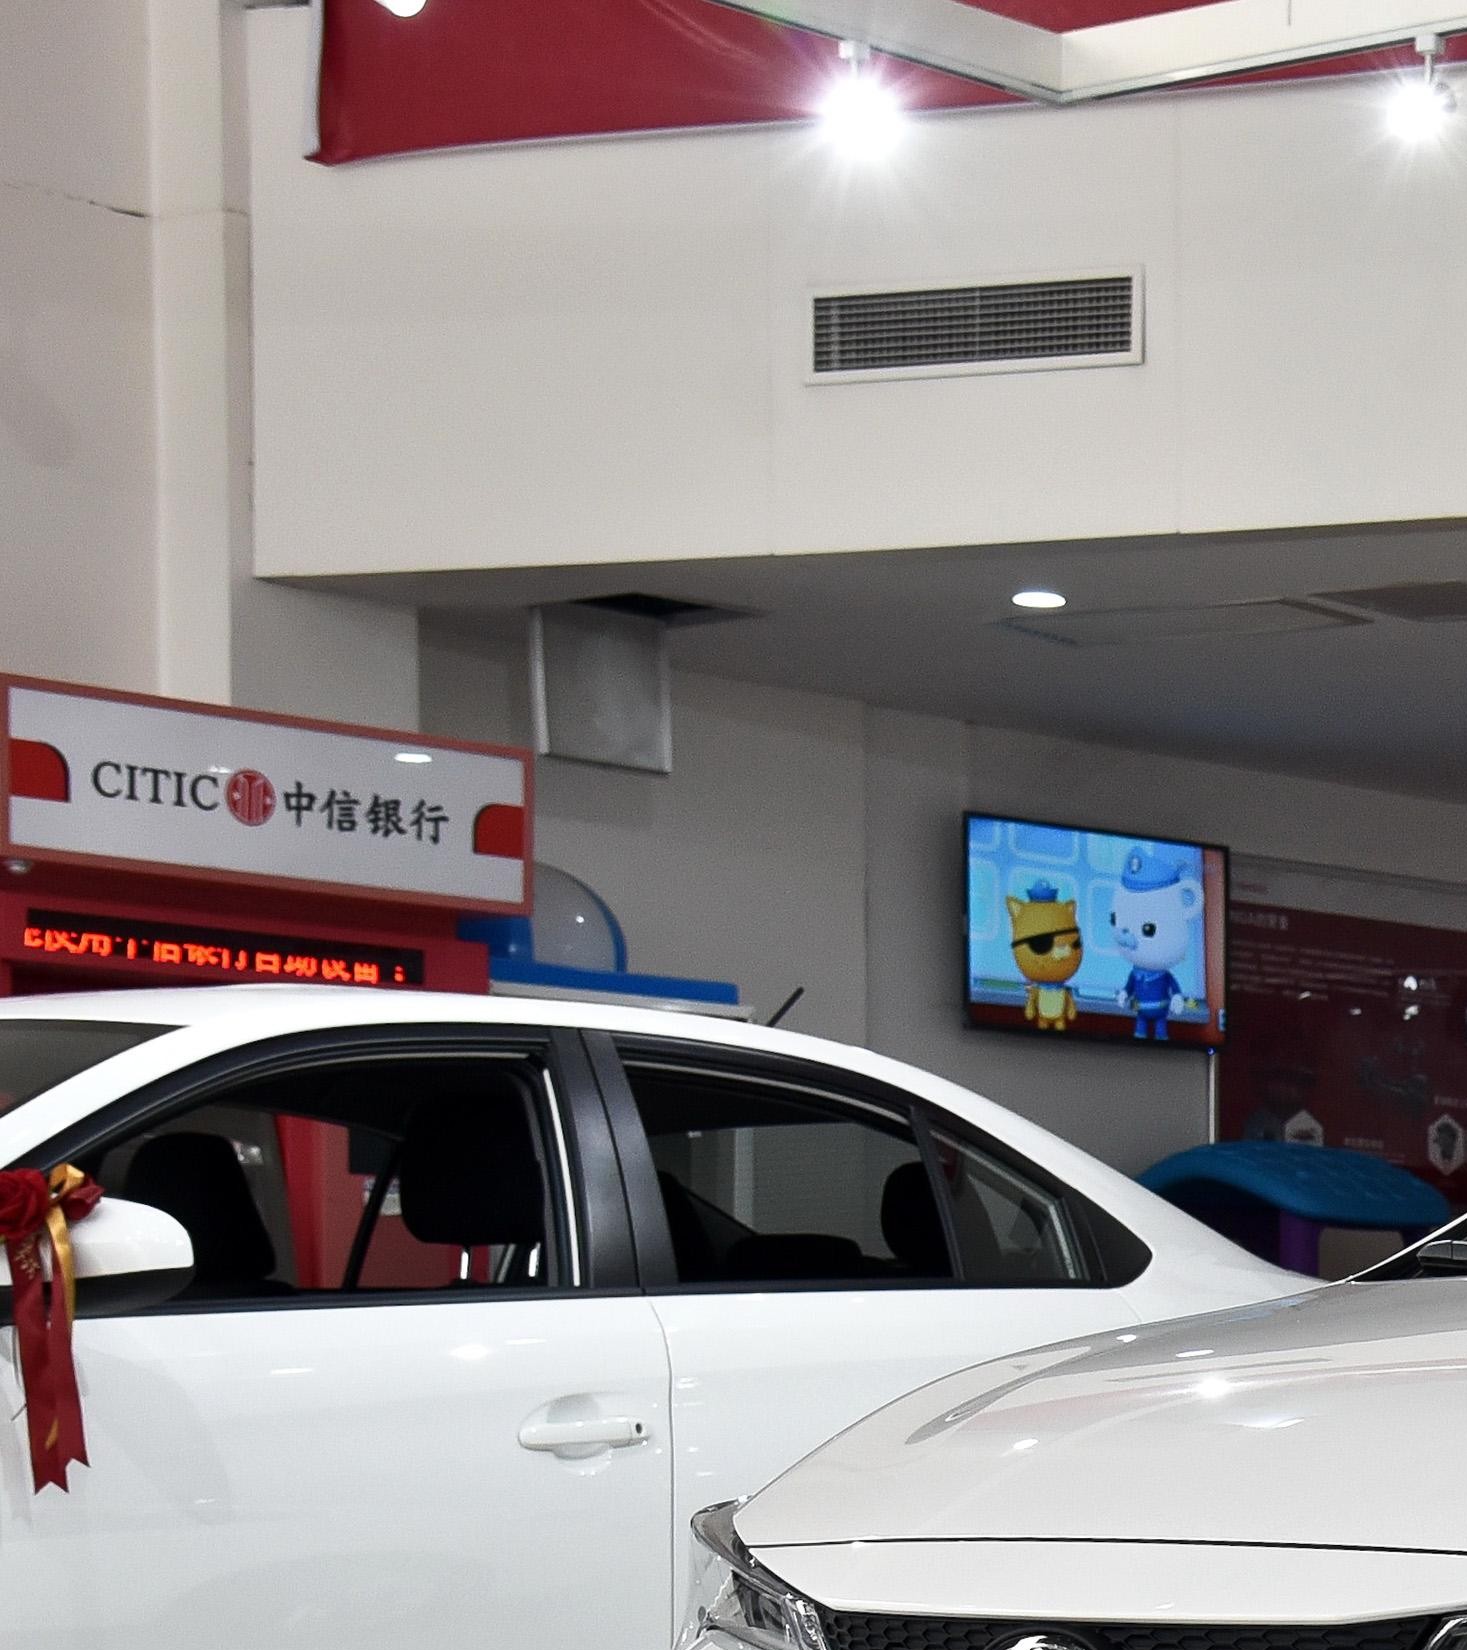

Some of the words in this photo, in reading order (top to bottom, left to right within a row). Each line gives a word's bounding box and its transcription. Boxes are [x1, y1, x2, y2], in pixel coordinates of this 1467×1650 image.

[91, 760, 220, 812] CITIC
[283, 780, 450, 845] 中信银行
